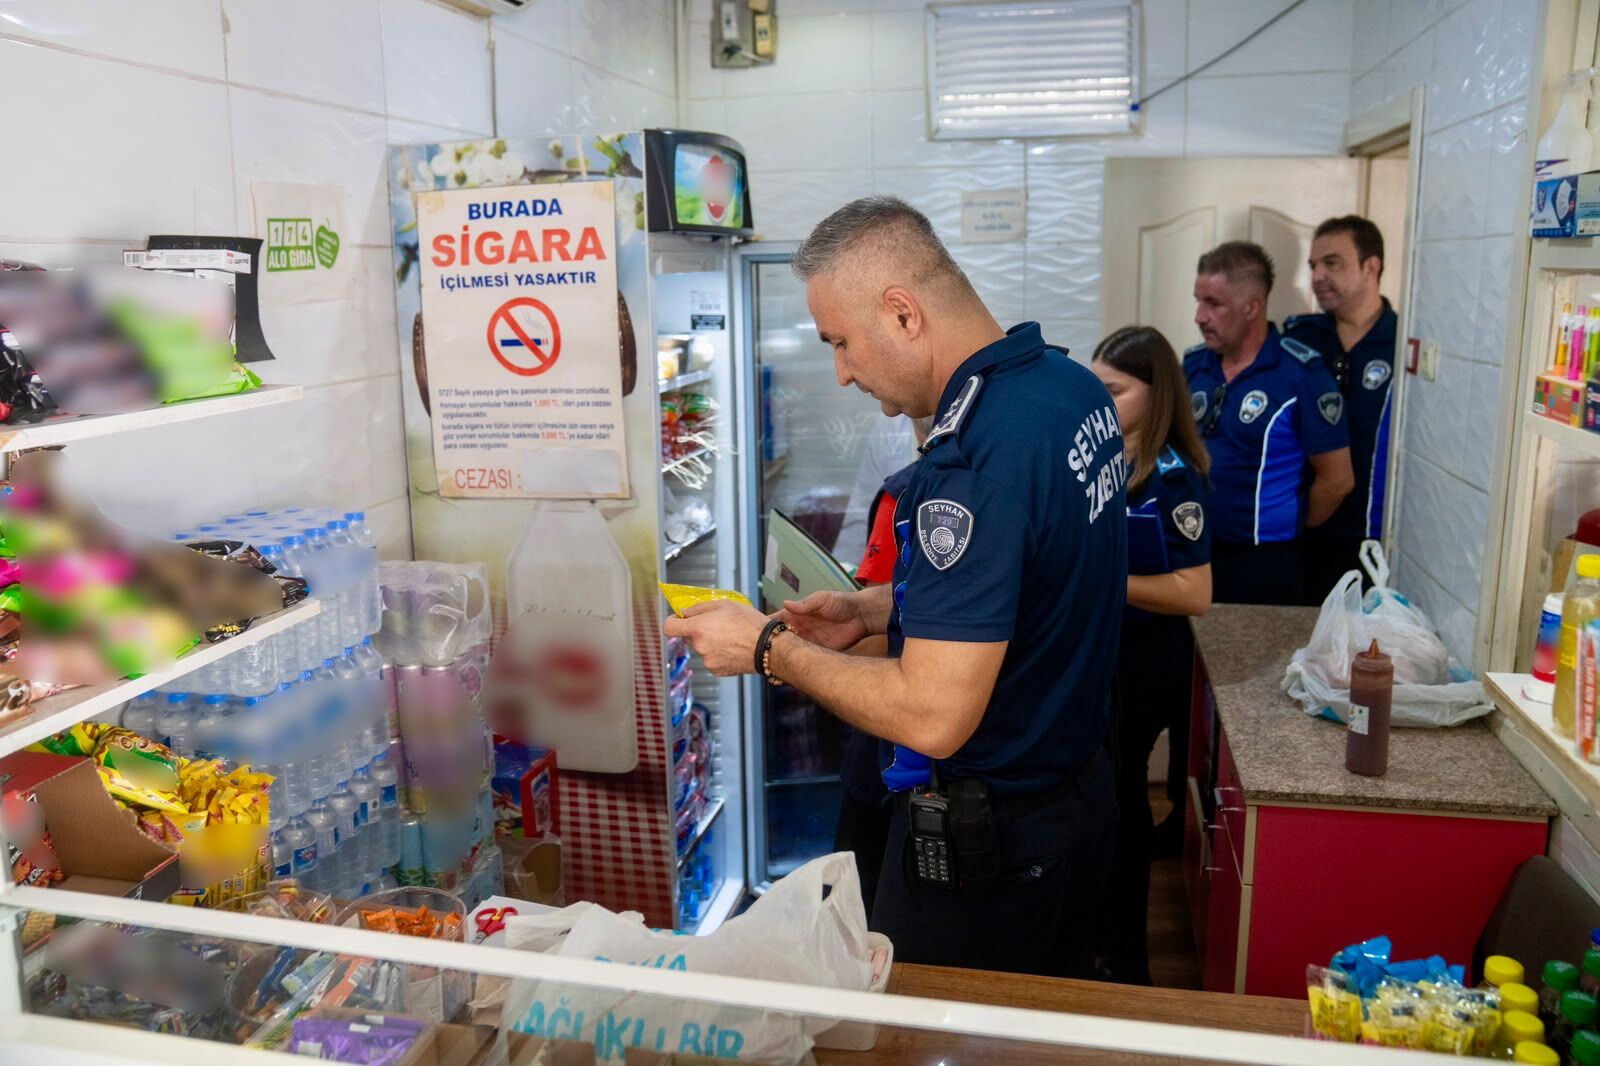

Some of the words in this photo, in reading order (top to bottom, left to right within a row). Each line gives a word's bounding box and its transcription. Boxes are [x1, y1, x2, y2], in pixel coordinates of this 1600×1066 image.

[468, 198, 562, 220] BURADA
[432, 225, 606, 267] SİGARA
[268, 250, 287, 269] ALO
[289, 249, 313, 268] GIDA
[440, 272, 509, 291] İÇİLMESİ
[515, 271, 597, 287] YASAKTIR
[495, 388, 509, 397] göre
[1067, 406, 1122, 483] SEYHA
[455, 468, 513, 489] CEZASI
[1085, 448, 1128, 525] ZABIT
[928, 504, 964, 519] SEYHAN
